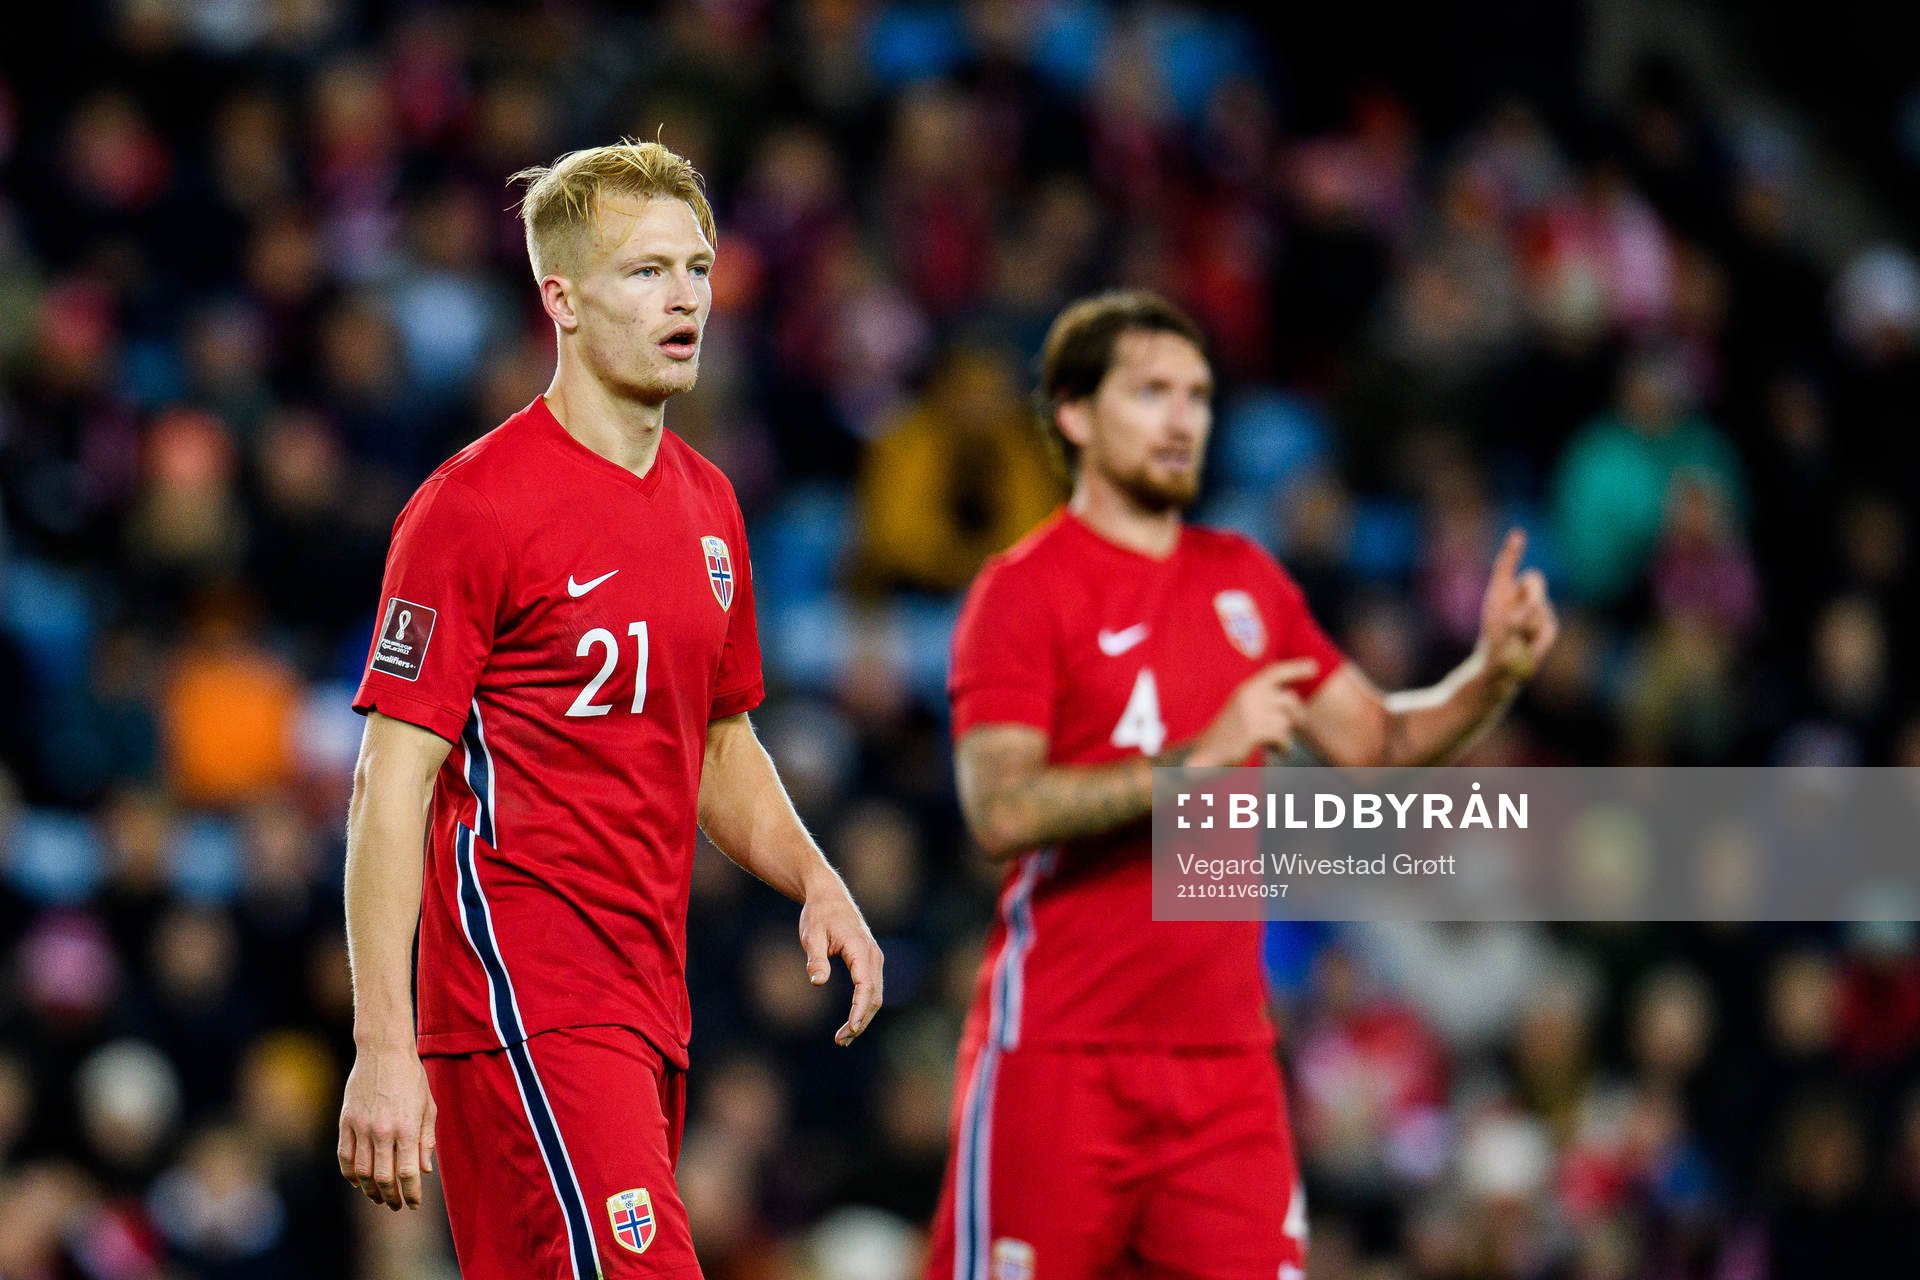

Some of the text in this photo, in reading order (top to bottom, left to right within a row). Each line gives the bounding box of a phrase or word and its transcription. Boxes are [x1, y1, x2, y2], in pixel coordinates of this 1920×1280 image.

[376, 652, 410, 669] Qualifiers
[565, 621, 648, 717] 21
[1110, 667, 1167, 756] 4
